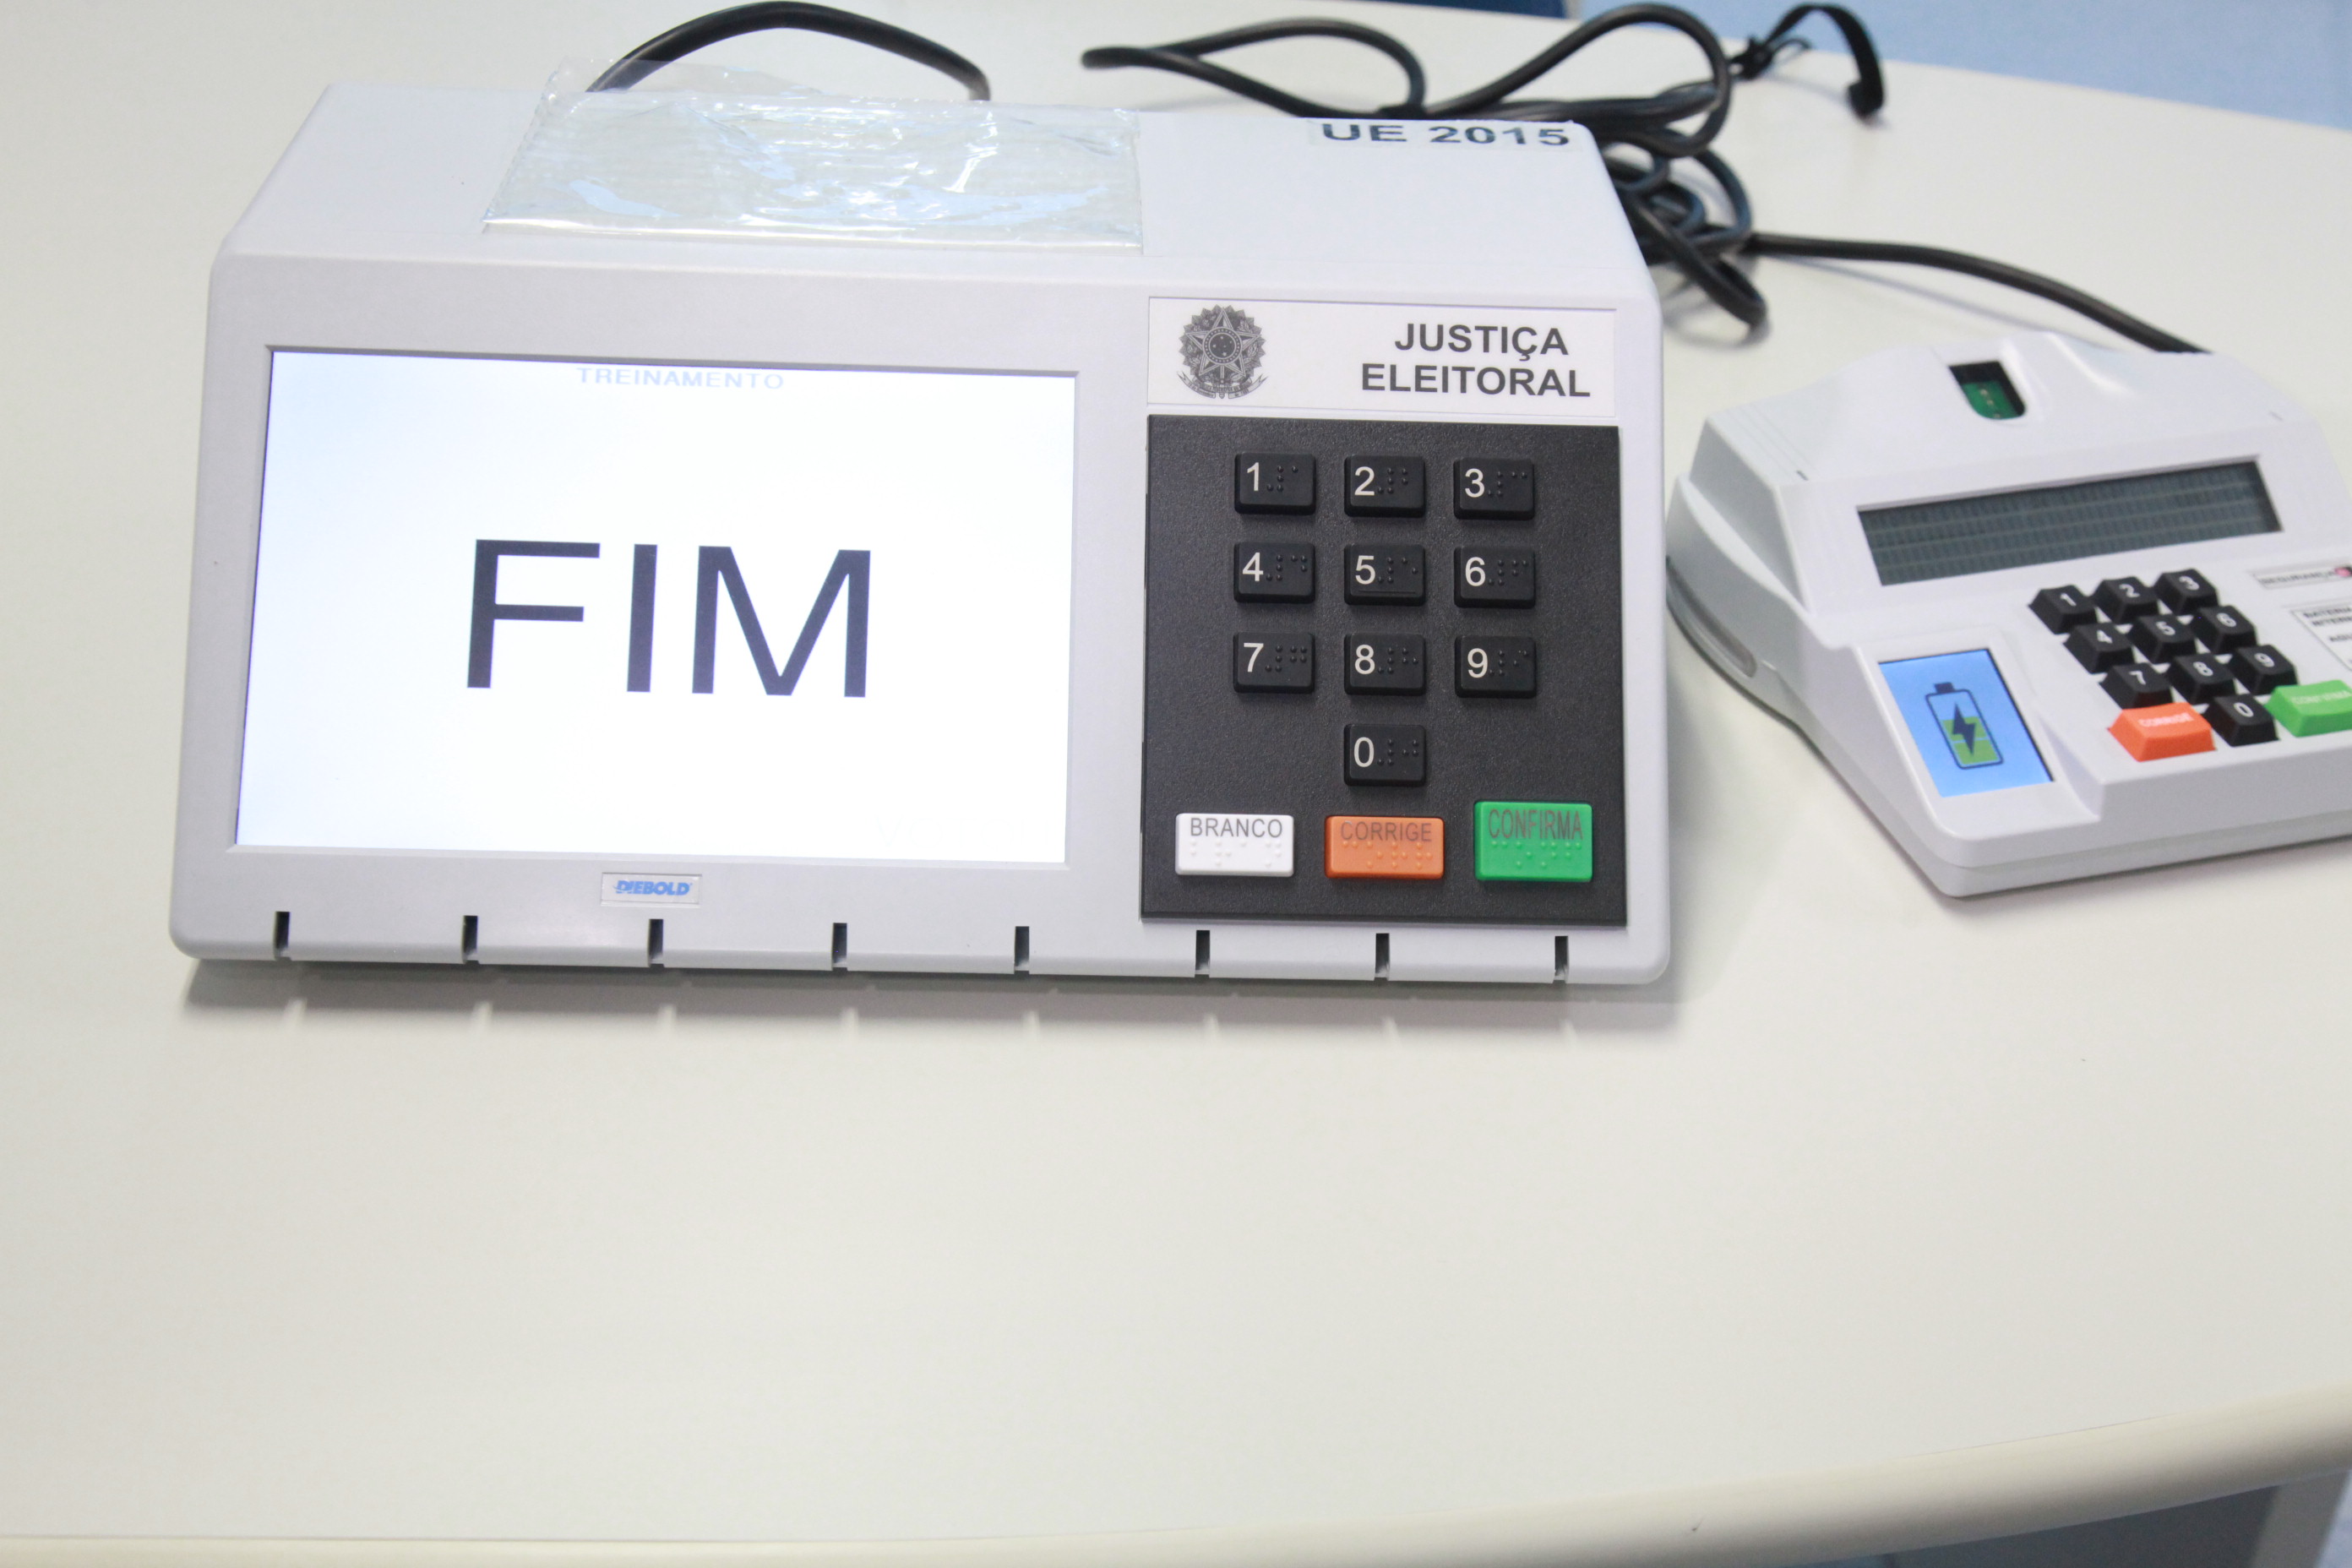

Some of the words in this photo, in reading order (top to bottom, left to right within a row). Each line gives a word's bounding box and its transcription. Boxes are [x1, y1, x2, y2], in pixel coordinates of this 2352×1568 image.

[1321, 123, 1407, 142] UE
[1429, 126, 1570, 145] 2015
[1395, 324, 1569, 361] JUSTIÇA
[577, 367, 784, 389] TREINAMENTO
[1362, 362, 1591, 397] ELEITORAL
[1246, 462, 1260, 492] 1
[1354, 466, 1375, 496] 2
[1465, 469, 1485, 498] 3
[1242, 552, 1264, 582] 4
[1355, 555, 1376, 585] 5
[1465, 557, 1486, 586] 6
[2120, 584, 2141, 598] 2
[2179, 575, 2200, 591] 3
[2061, 593, 2077, 607] 1
[467, 539, 871, 698] FIM
[2156, 621, 2176, 635] 5
[2217, 612, 2237, 628] 6
[2097, 630, 2112, 644] 4
[1244, 643, 1264, 672] 7
[1354, 645, 1375, 674] 8
[1467, 648, 1489, 678] 9
[2255, 652, 2275, 667] 9
[2130, 670, 2146, 685] 7
[2193, 662, 2213, 677] 8
[2234, 702, 2254, 717] 0
[1353, 738, 1375, 768] 0
[1190, 817, 1283, 838] BRANCO
[1340, 821, 1432, 842] CORRIGE
[1489, 808, 1583, 840] CONFIRMA
[614, 880, 690, 896] DIEBOLD
